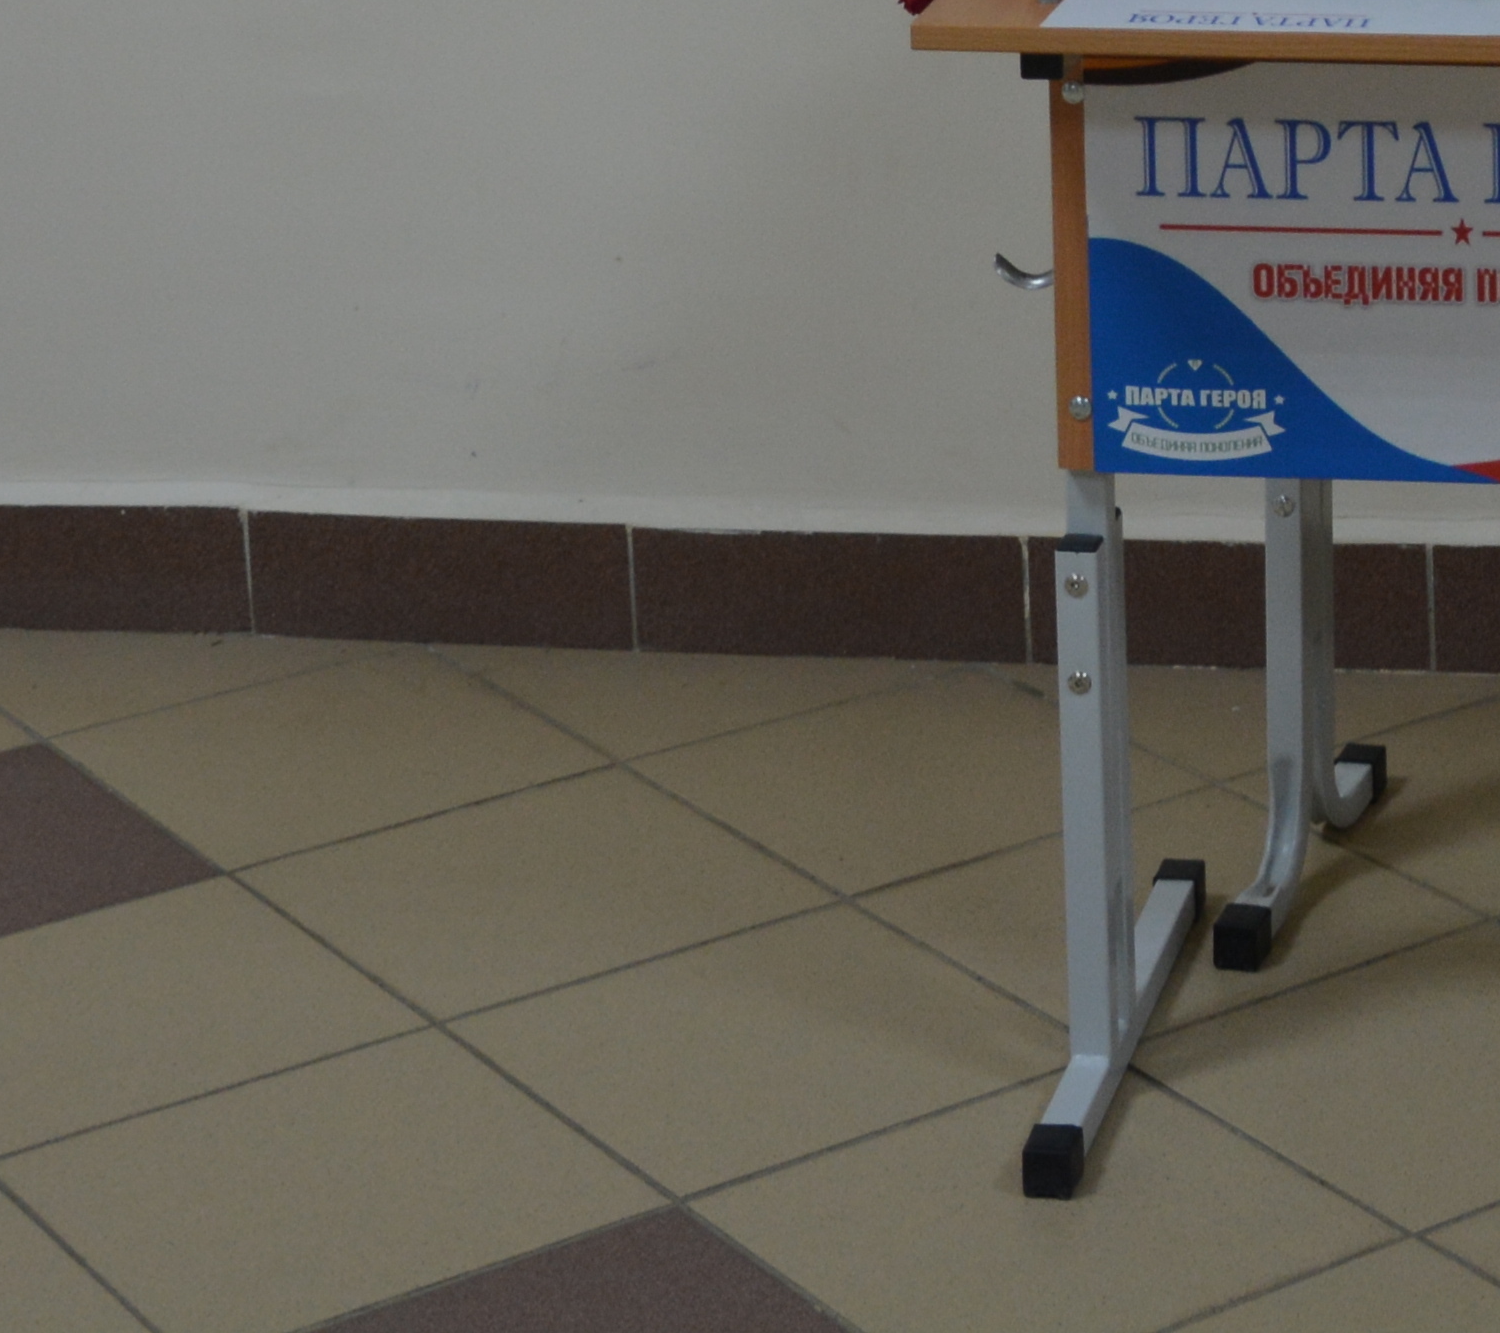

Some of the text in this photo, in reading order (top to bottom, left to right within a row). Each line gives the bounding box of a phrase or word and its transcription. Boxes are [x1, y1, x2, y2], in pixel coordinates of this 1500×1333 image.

[1128, 13, 1371, 28] ПАРТА ГЕРОЯ
[1133, 115, 1460, 204] ПАРТА
[1251, 263, 1465, 308] ОБЪЕДИНЯЯ
[1125, 385, 1267, 410] ПАРТА ГЕРОЯ
[1131, 432, 1263, 453] ОБЪЕДИНЯЯ ПОКОЛЕНИЯ
